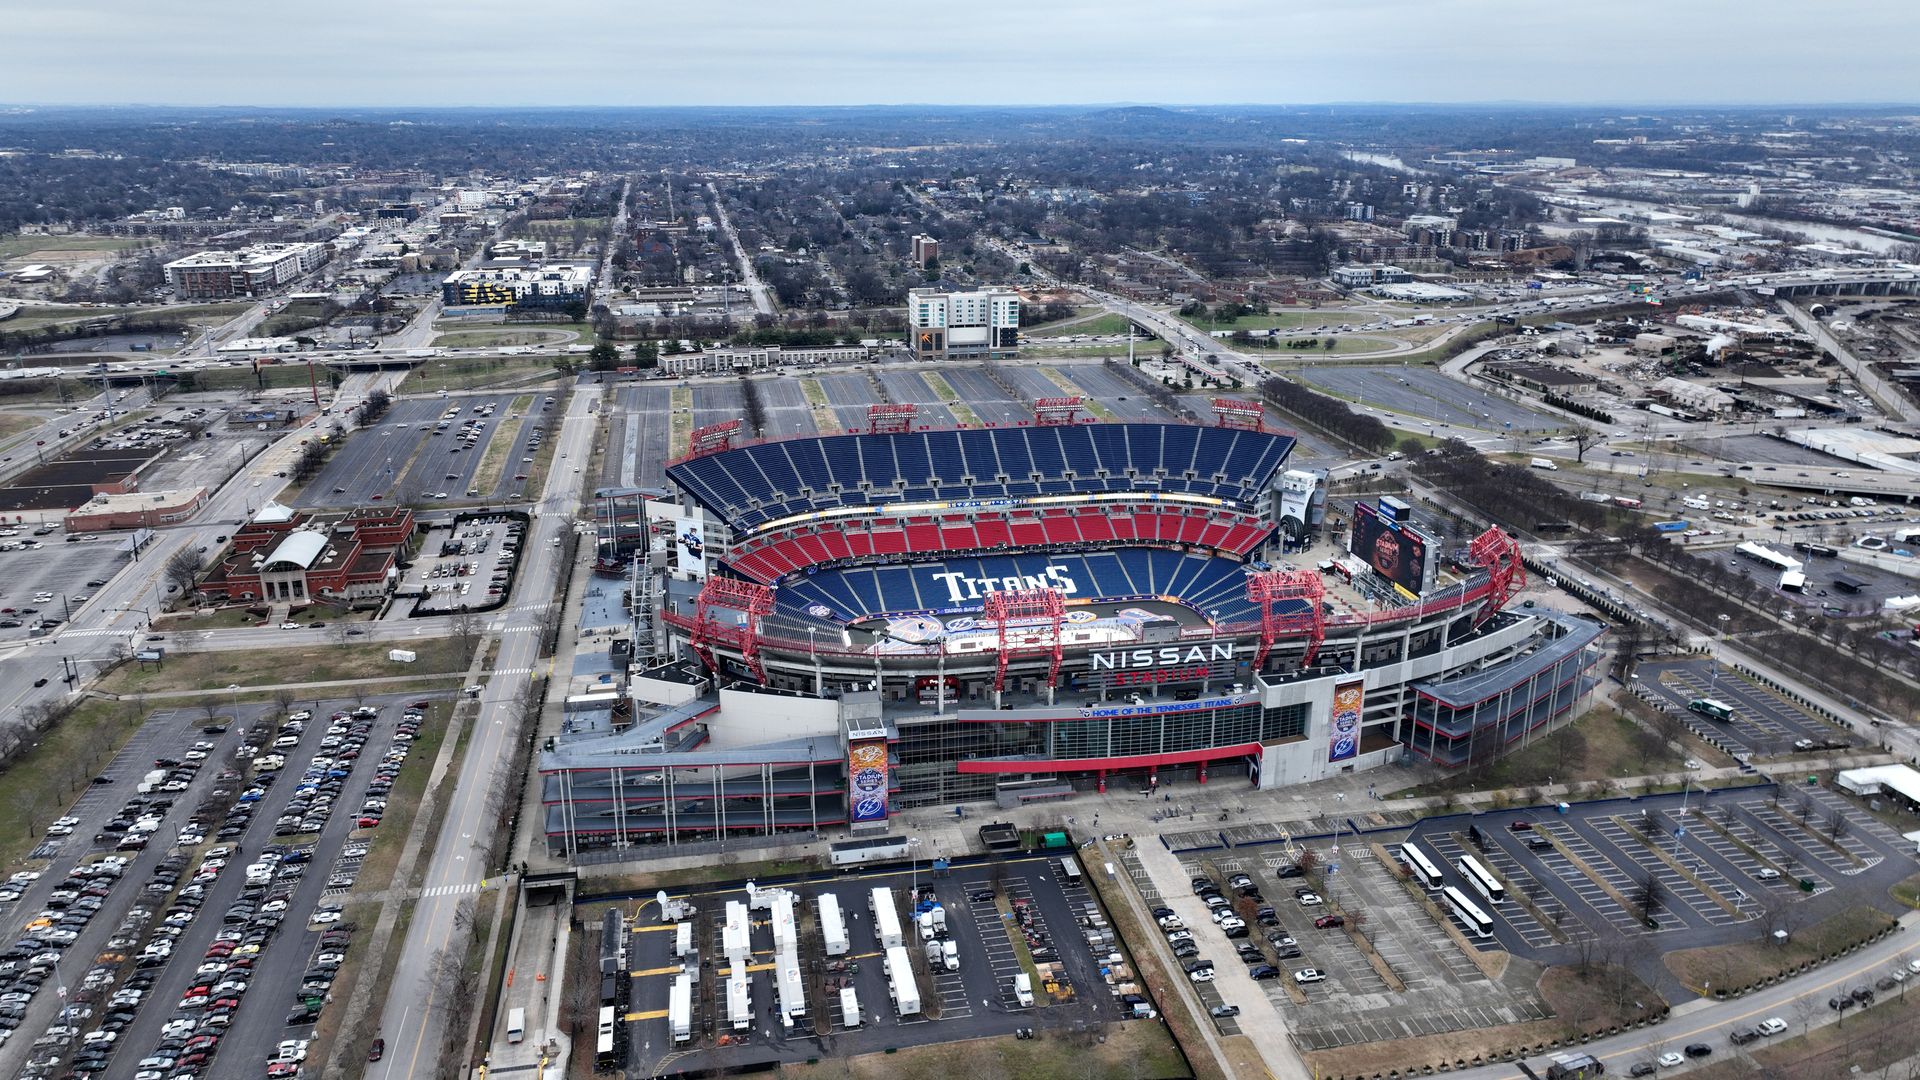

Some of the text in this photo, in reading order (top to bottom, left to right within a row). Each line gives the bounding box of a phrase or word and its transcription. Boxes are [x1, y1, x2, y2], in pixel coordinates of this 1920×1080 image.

[932, 565, 1077, 601] TITANS
[1093, 643, 1233, 670] NISSAN
[1115, 667, 1209, 685] STADIUM
[1092, 698, 1232, 717] HOME OF THE TENNESSEE TITANS
[854, 773, 884, 782] STADIUM
